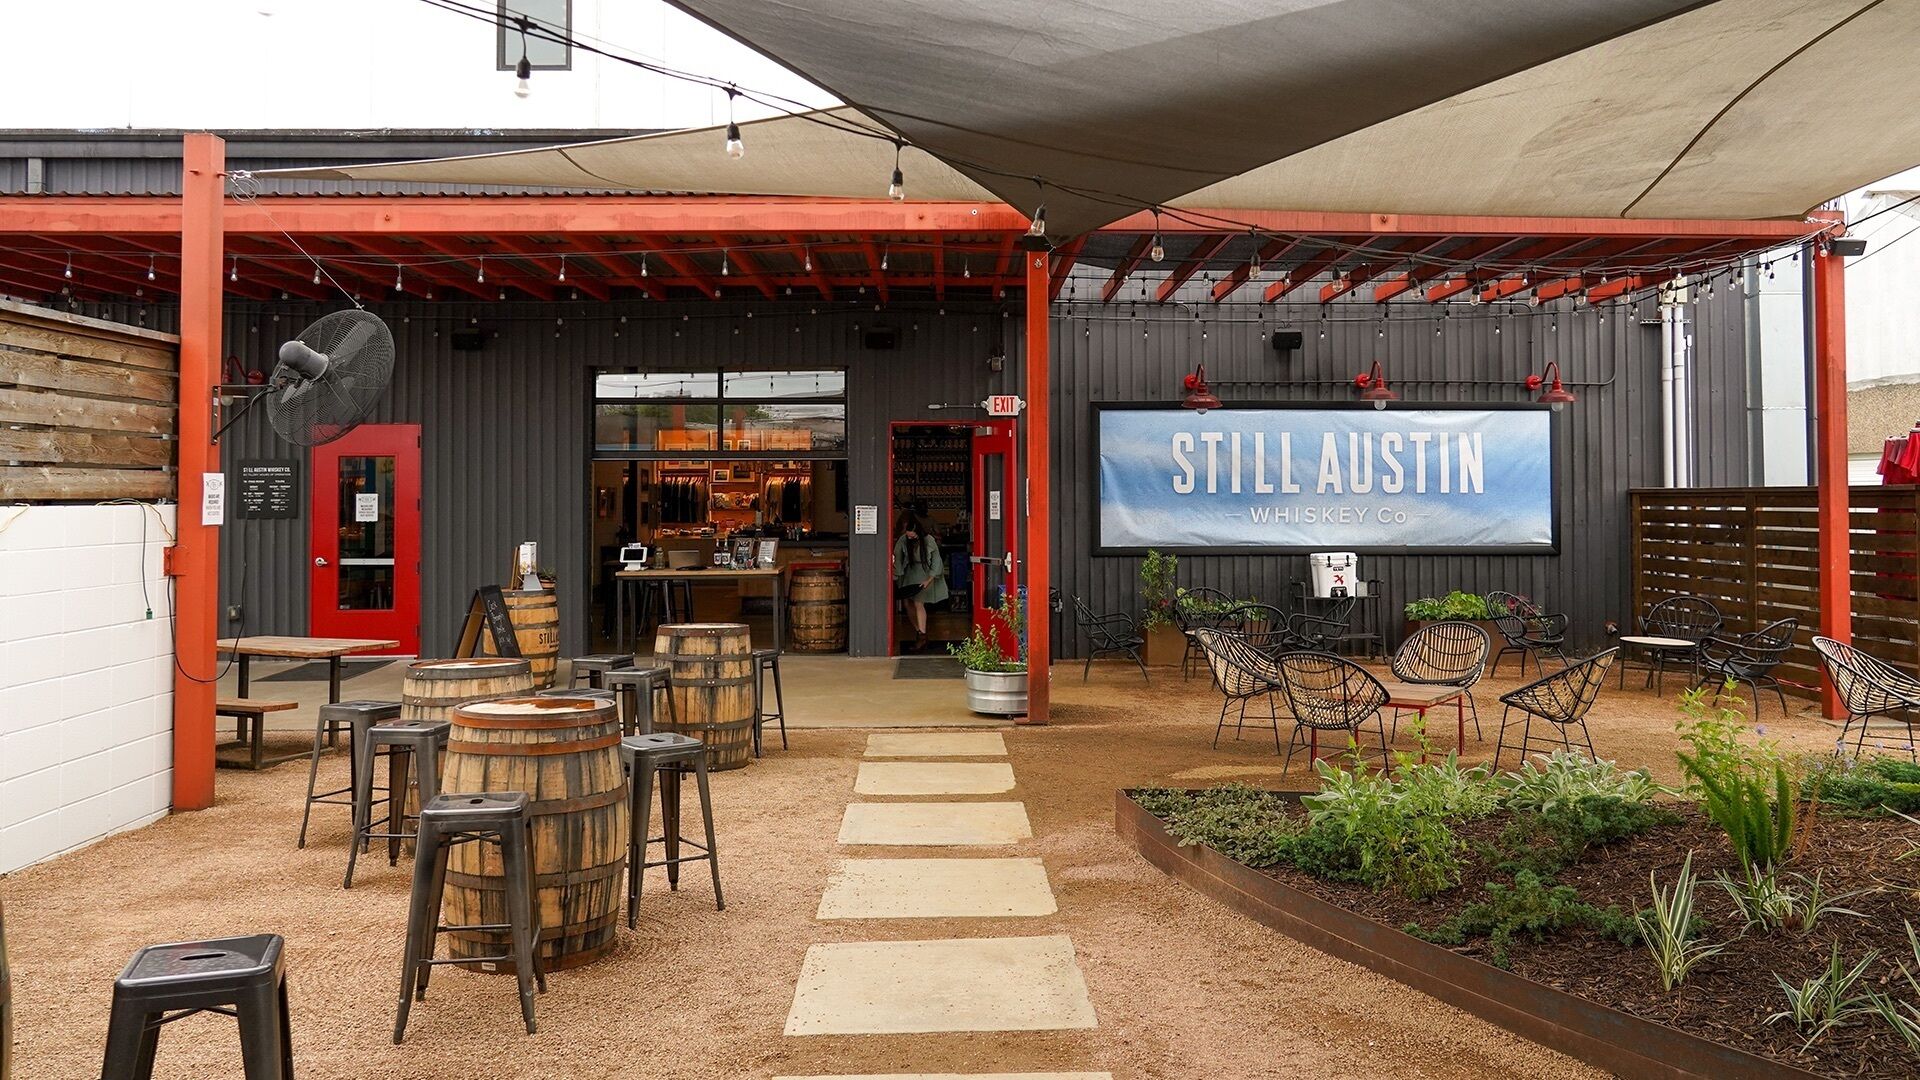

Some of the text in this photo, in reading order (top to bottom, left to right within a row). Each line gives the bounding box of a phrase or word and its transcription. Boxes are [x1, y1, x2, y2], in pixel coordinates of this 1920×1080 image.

[994, 397, 1015, 412] EXIT
[1172, 432, 1484, 494] STILL AUSTIN
[1250, 507, 1407, 523] WHISKEY Co
